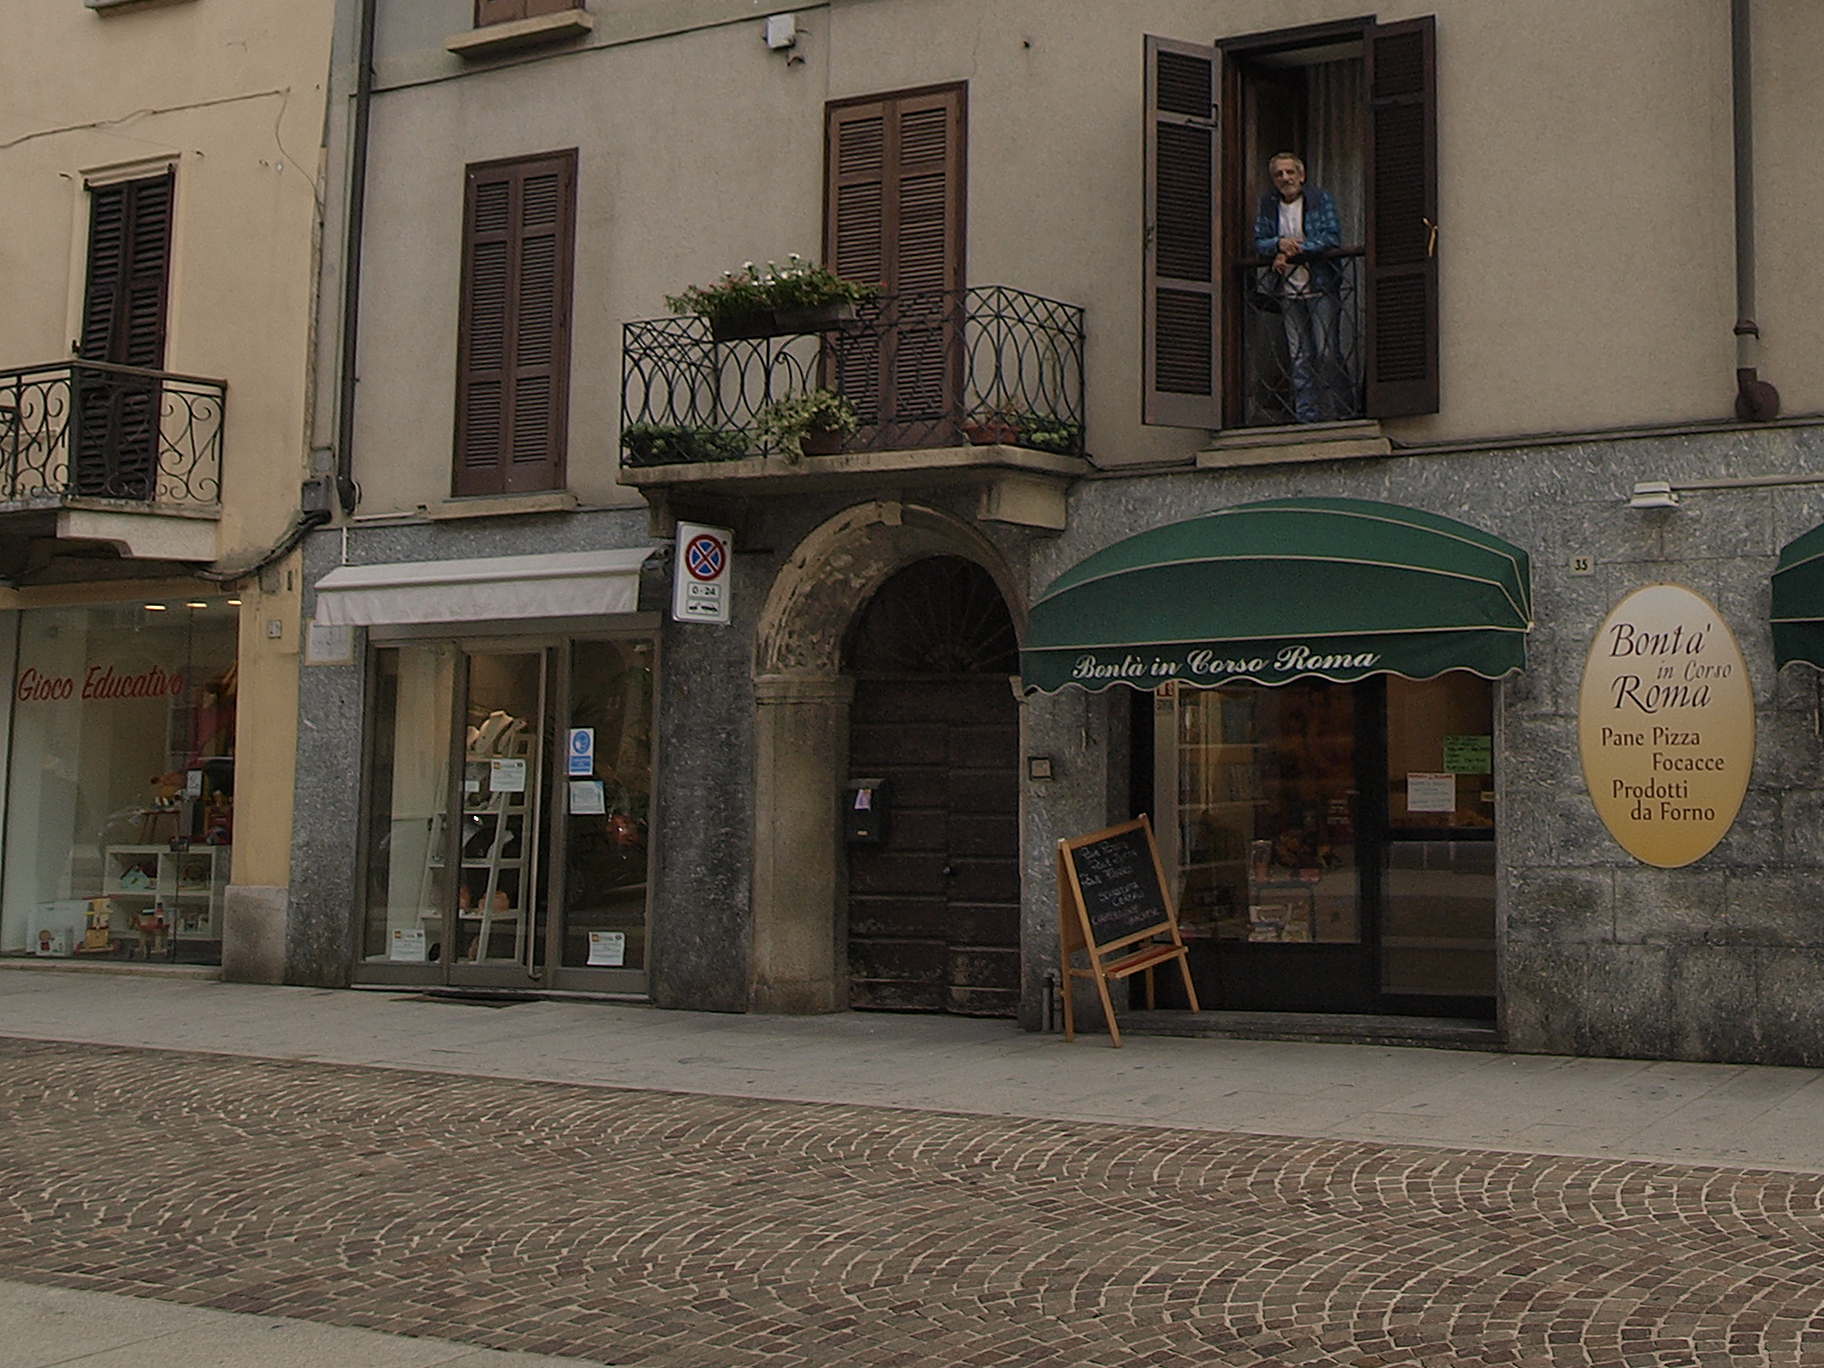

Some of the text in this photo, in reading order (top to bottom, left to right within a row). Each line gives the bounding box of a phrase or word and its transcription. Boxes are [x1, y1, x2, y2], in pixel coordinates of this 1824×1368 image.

[1574, 559, 1588, 571] 35
[1071, 645, 1383, 680] Bontà in Corso Roma
[1656, 659, 1733, 682] in Corso
[17, 664, 185, 702] Gioco Educativo
[1611, 674, 1712, 715] Roma
[1601, 725, 1701, 747] Pane Pizza
[1652, 751, 1726, 772] Focacce
[1612, 777, 1689, 800] Prodotti
[1630, 799, 1716, 821] da Forno
